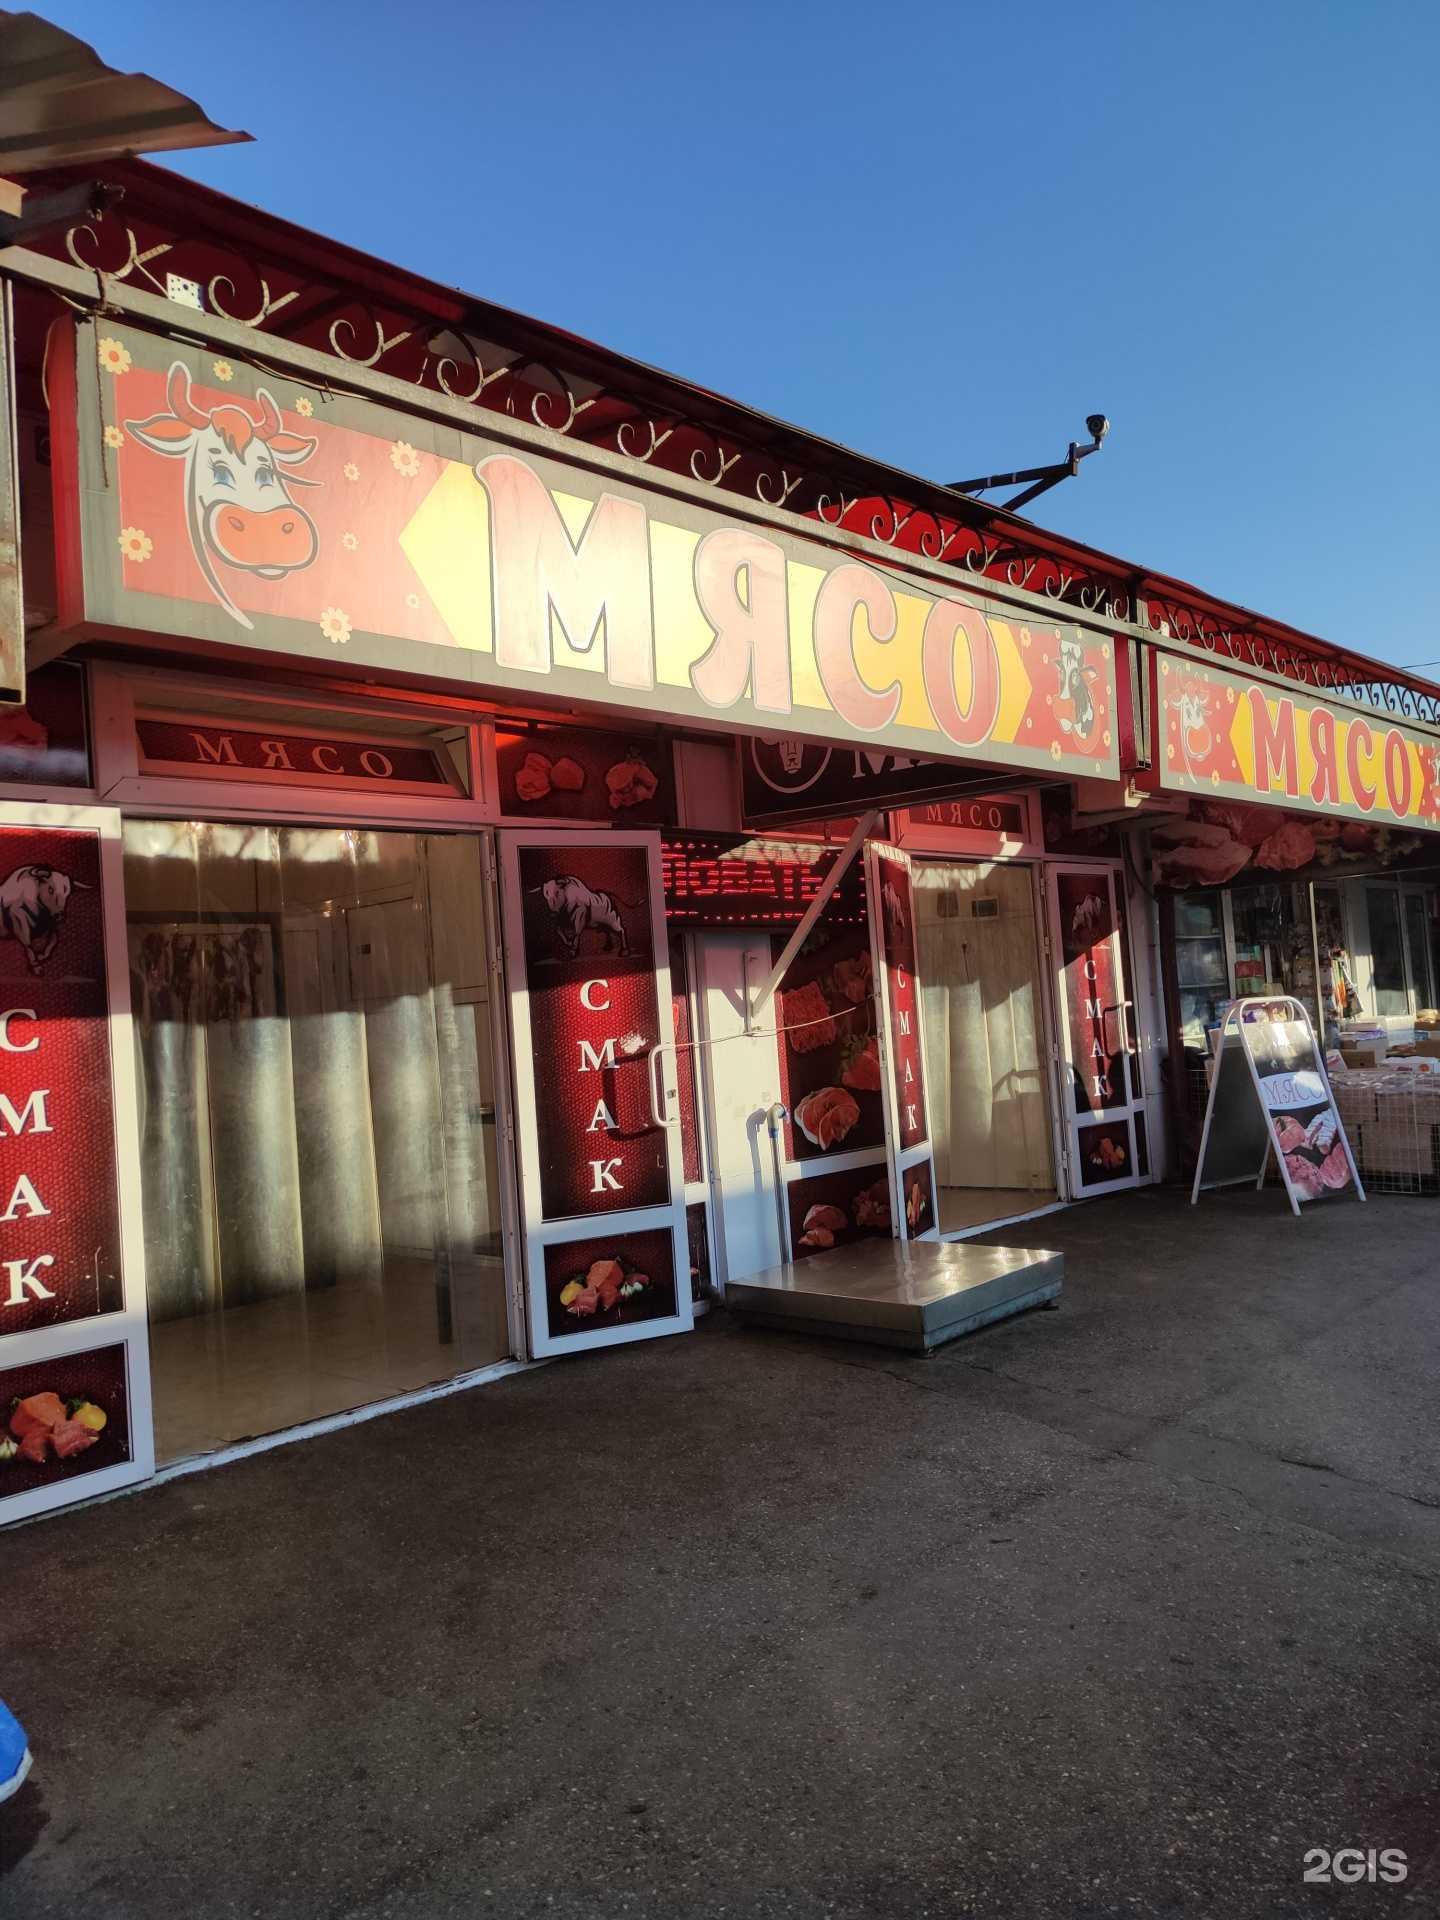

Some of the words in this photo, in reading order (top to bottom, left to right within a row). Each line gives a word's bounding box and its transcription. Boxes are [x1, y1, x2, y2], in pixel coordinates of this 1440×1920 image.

[475, 454, 1000, 748] МЯСО
[189, 733, 393, 778] МЯСО
[927, 803, 1002, 828] МЯСО
[1247, 685, 1411, 819] МЯСО
[577, 979, 624, 1193] СМАК
[897, 964, 917, 1131] СМАК
[1083, 960, 1112, 1098] СМАК
